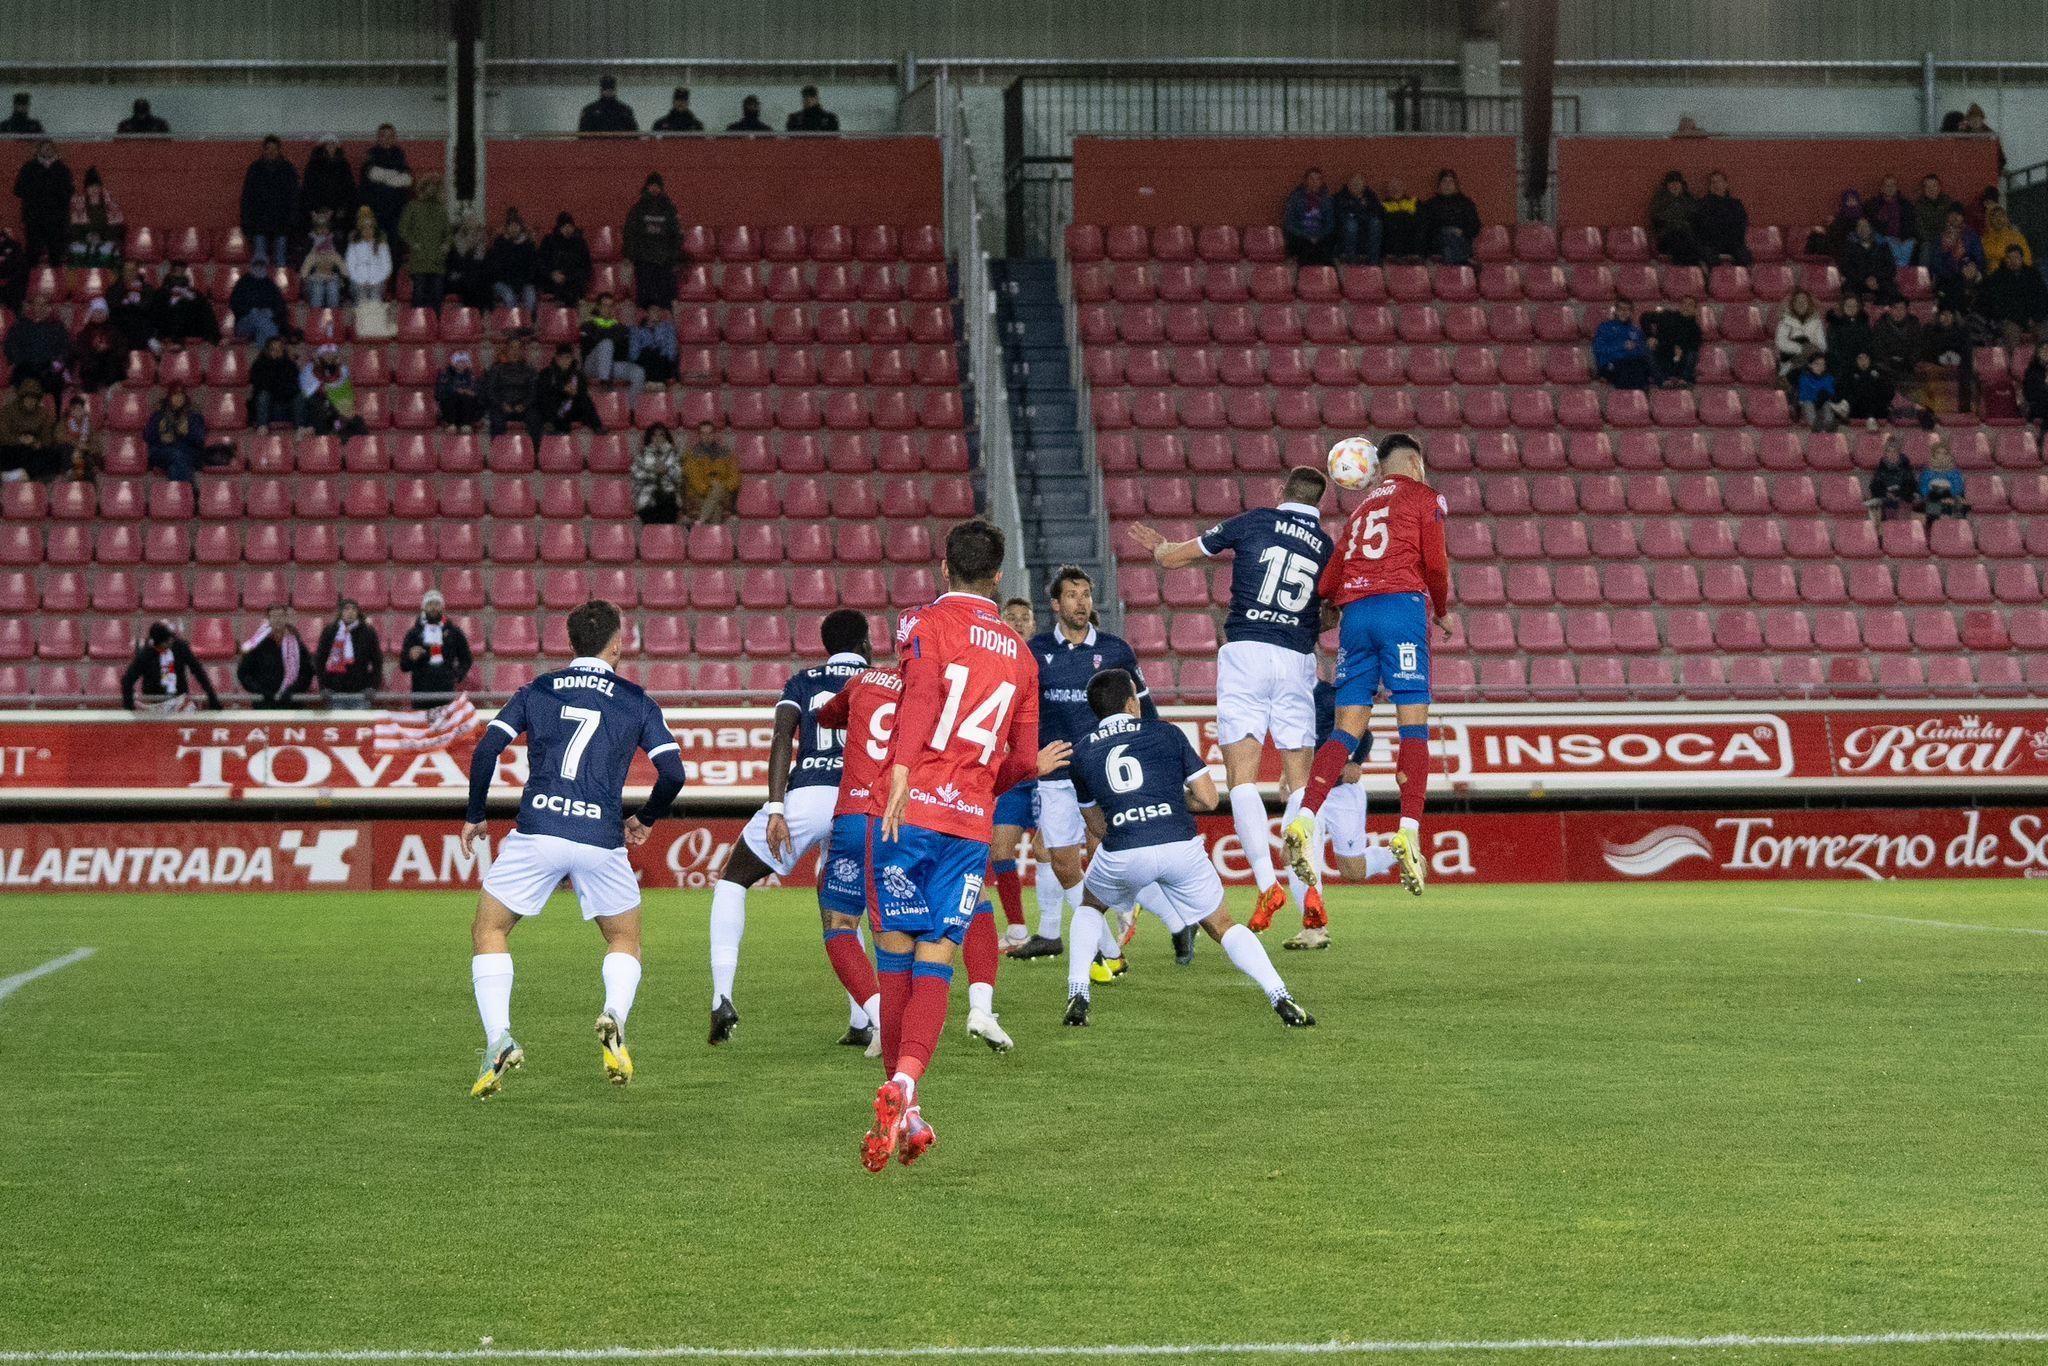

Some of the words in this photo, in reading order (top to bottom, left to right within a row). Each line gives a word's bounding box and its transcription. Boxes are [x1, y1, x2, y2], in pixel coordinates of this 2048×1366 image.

[1274, 520, 1324, 554] MARKEL
[1344, 506, 1390, 560] 15
[1257, 545, 1319, 612] 15
[969, 624, 1018, 660] MOHA
[553, 675, 615, 697] DONCEL
[866, 702, 897, 761] 9
[930, 662, 1017, 766] 14
[1089, 723, 1142, 743] ARREGI
[560, 705, 601, 780] 7
[1484, 732, 1771, 766] INSOCA
[1839, 723, 2025, 772] Real
[1105, 744, 1144, 793] 6
[909, 788, 938, 805] Caja
[956, 799, 985, 817] Soria
[0, 847, 274, 884] LAENTRADA
[1714, 817, 1937, 880] Torrezno
[1944, 809, 2000, 867] de
[885, 907, 901, 917] Los
